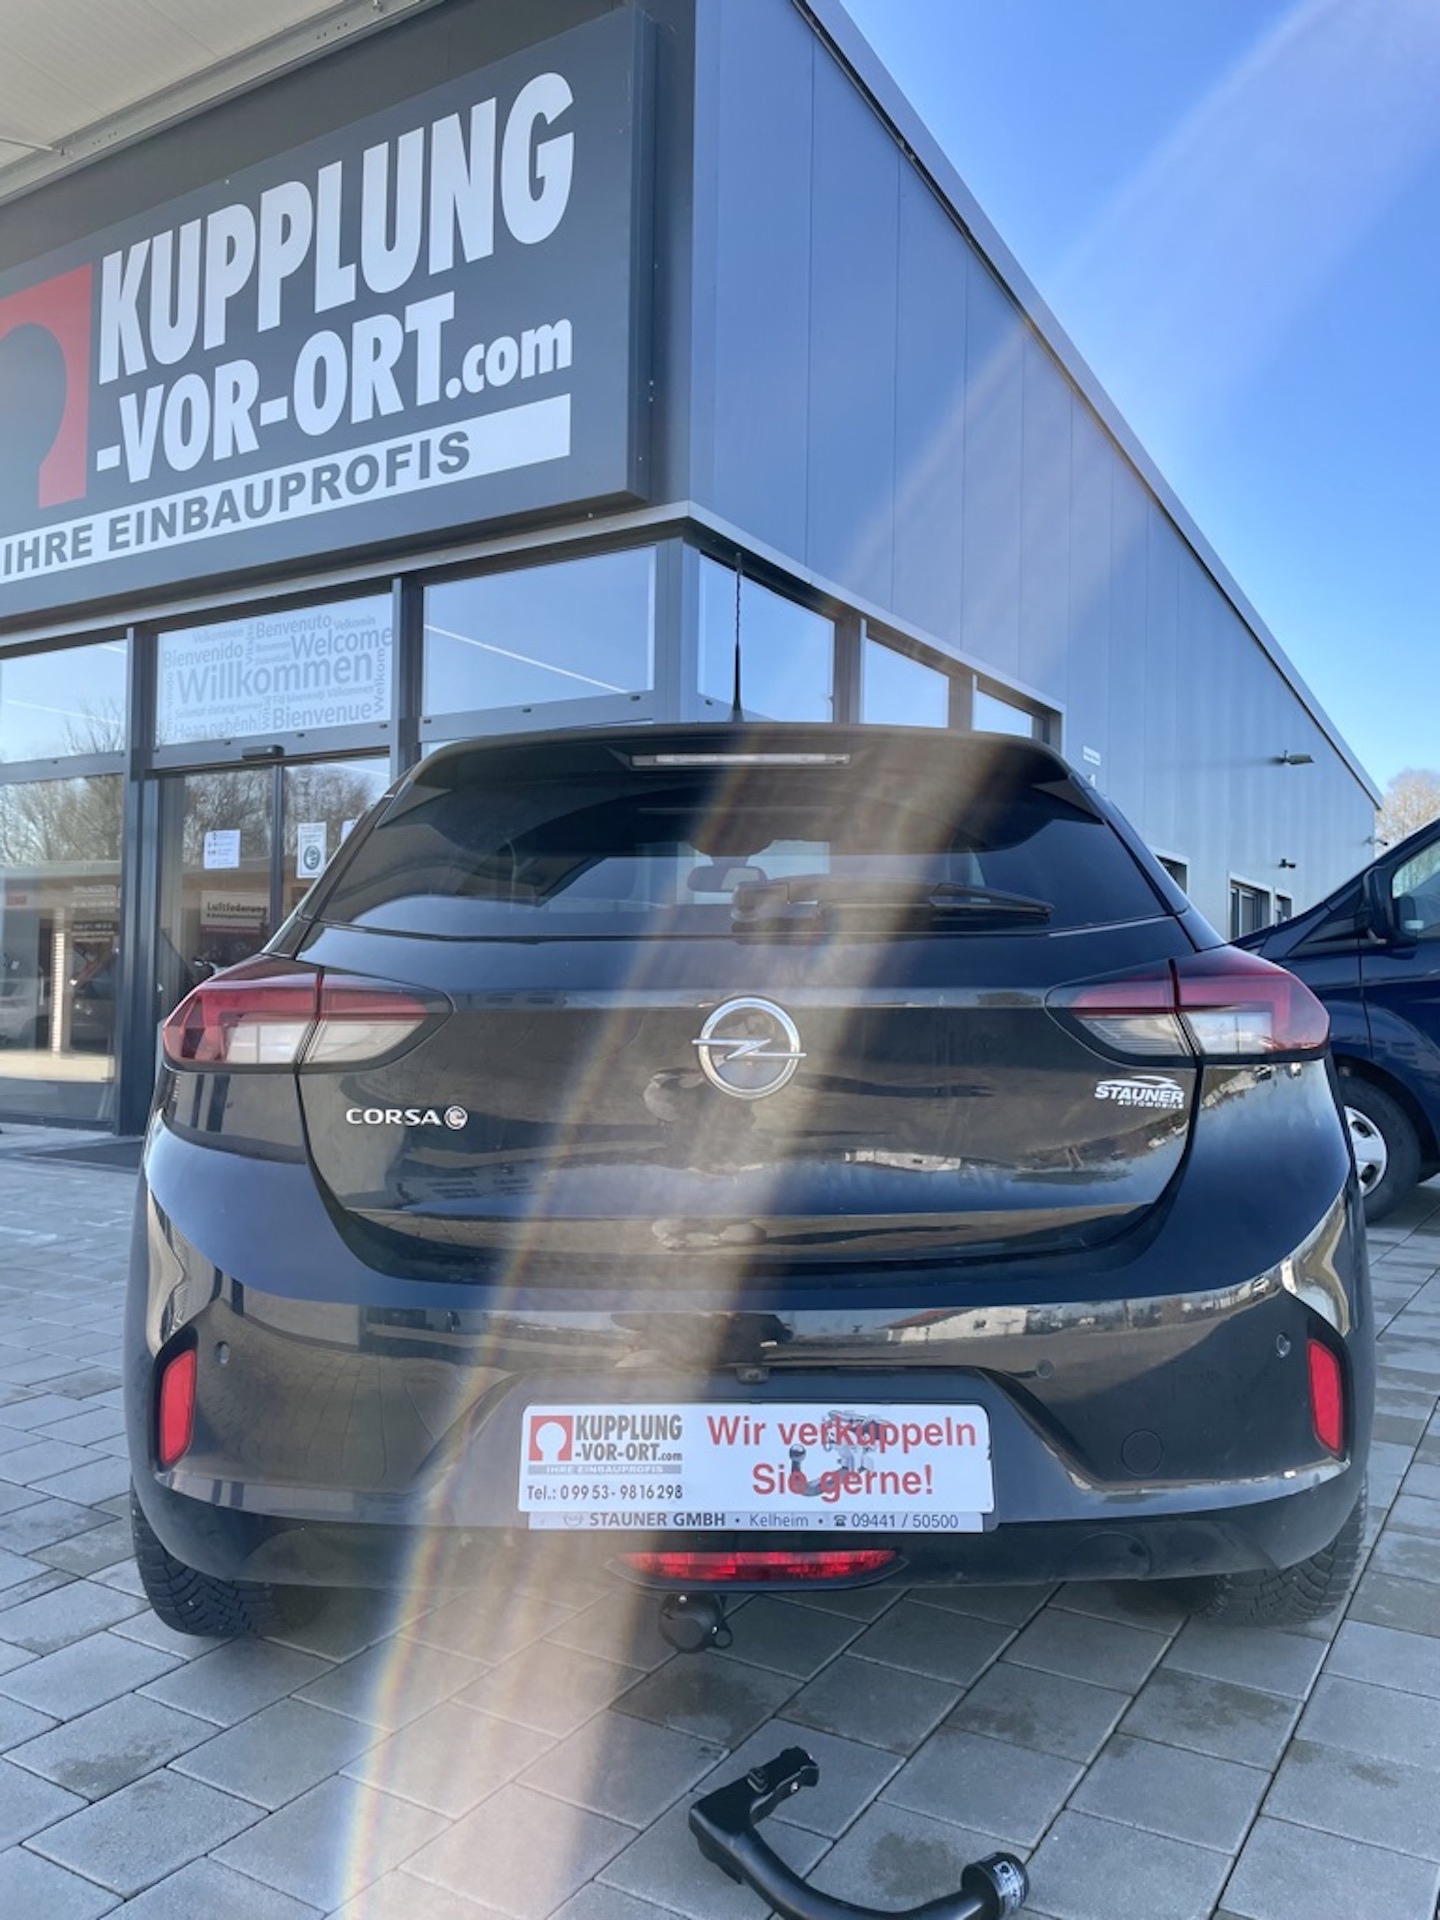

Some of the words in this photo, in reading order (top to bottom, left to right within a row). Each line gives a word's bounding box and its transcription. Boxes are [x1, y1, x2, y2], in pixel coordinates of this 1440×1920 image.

[98, 71, 575, 385] KUPPLUNG
[96, 291, 573, 484] -VOR-ORT.com
[3, 523, 92, 577] IHRE
[107, 430, 471, 552] EINBAUPROFIS
[256, 614, 332, 640] Benvenuto
[163, 641, 244, 669] Bienvenido
[291, 626, 393, 660] Welcome
[177, 651, 372, 703] Willkommen
[272, 701, 372, 731] Bienvenue
[1094, 1084, 1185, 1103] STAUNER
[345, 1107, 443, 1126] CORSA
[575, 1414, 683, 1441] KUPPLUNG
[708, 1415, 766, 1447] Wir
[777, 1416, 977, 1454] verkuppeln
[575, 1443, 683, 1462] -VOR-ORT.com
[752, 1463, 808, 1496] Sie
[820, 1464, 933, 1504] gerne!
[590, 1512, 668, 1527] STAUNER
[673, 1512, 725, 1528] GMBH
[749, 1513, 810, 1528] Kelheim
[851, 1513, 896, 1528] 09441
[912, 1514, 959, 1529] 50500
